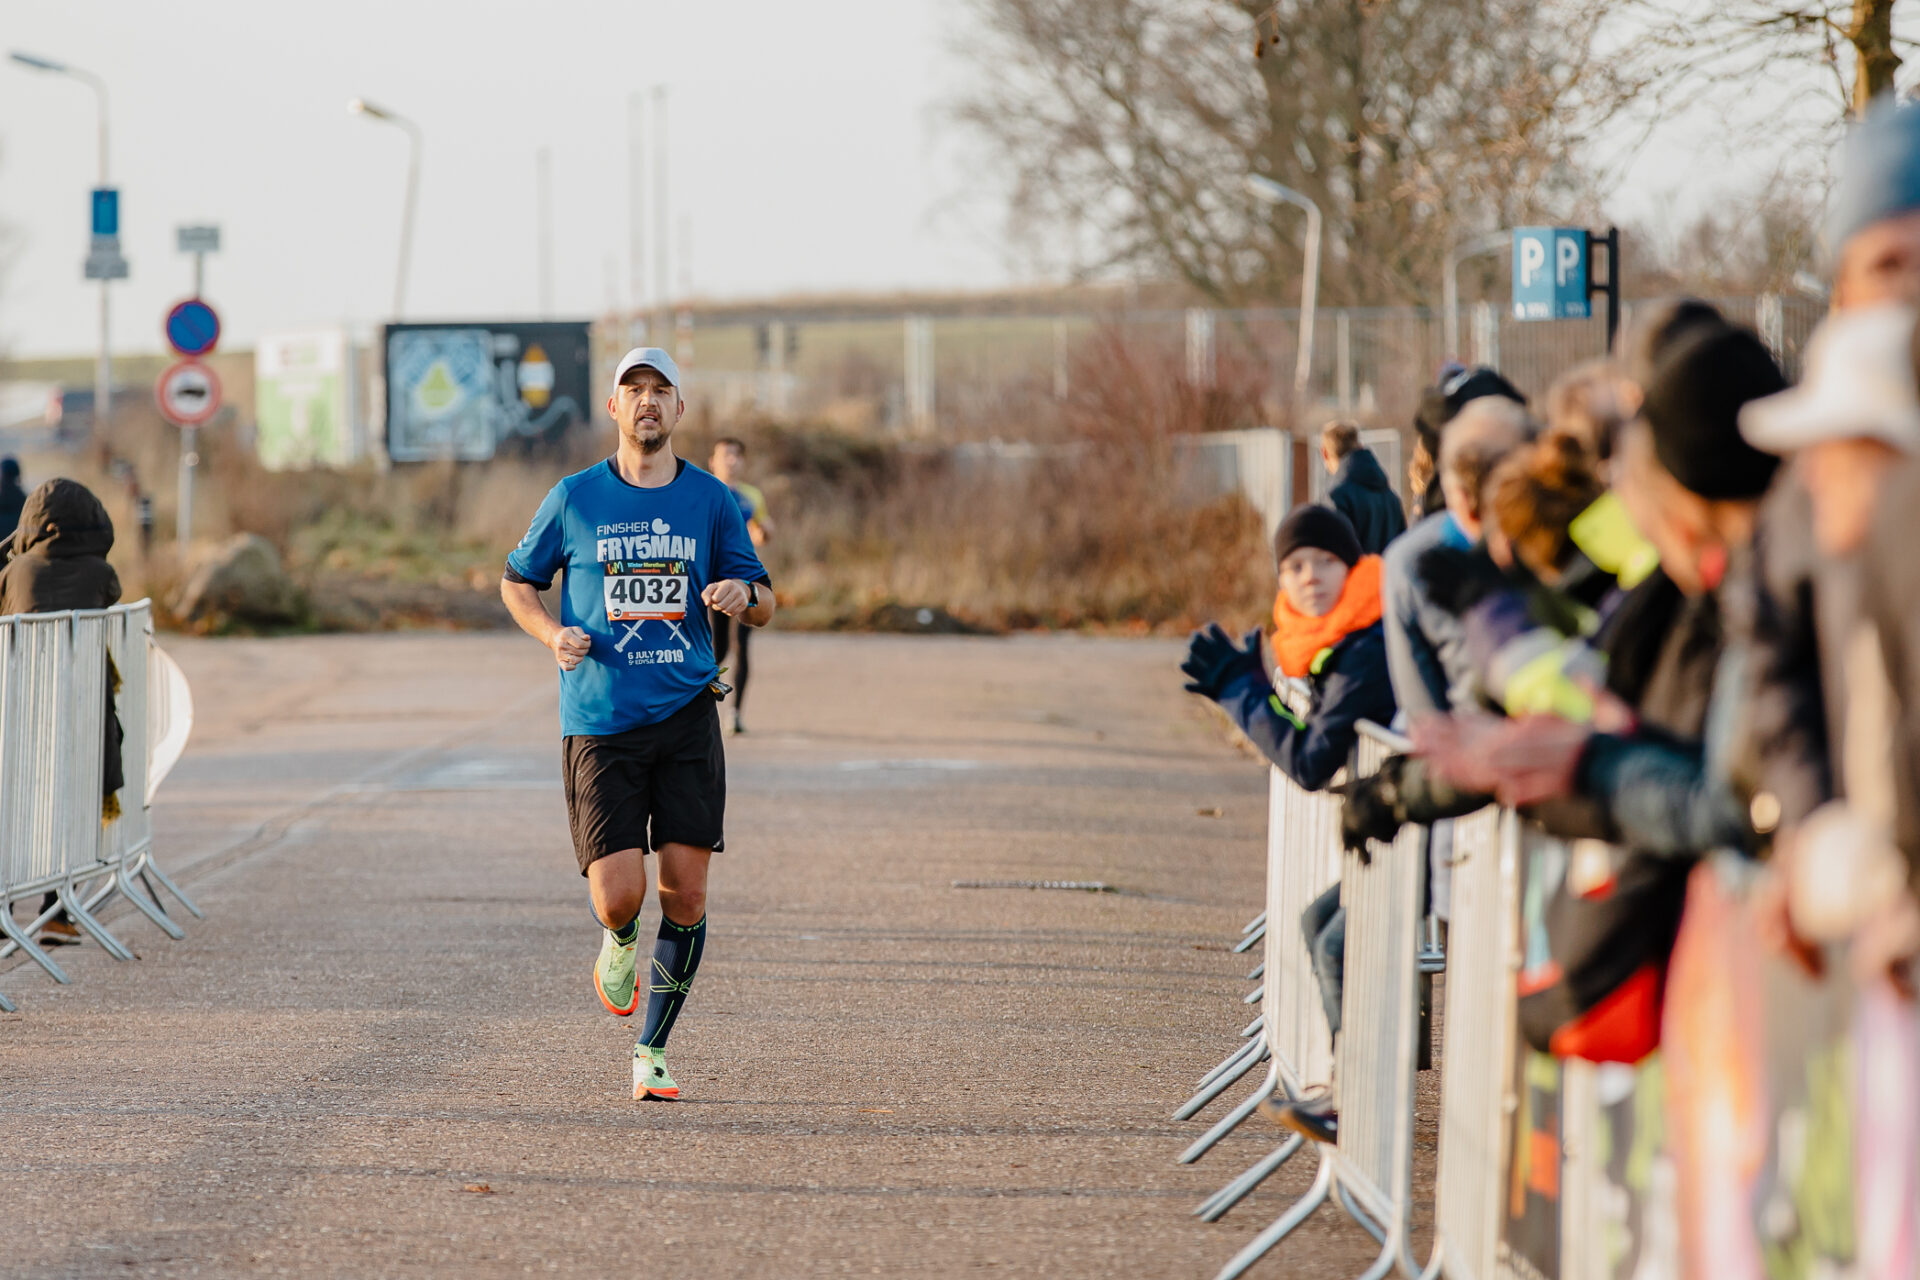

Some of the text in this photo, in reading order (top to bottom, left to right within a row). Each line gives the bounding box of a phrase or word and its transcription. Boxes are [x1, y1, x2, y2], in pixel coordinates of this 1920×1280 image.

[1520, 236, 1545, 288] P
[1556, 236, 1580, 287] P
[596, 521, 649, 536] FINISHER
[597, 534, 696, 562] FRY5MAN
[610, 578, 681, 603] 4032
[627, 649, 684, 663] 6 JULY 2019
